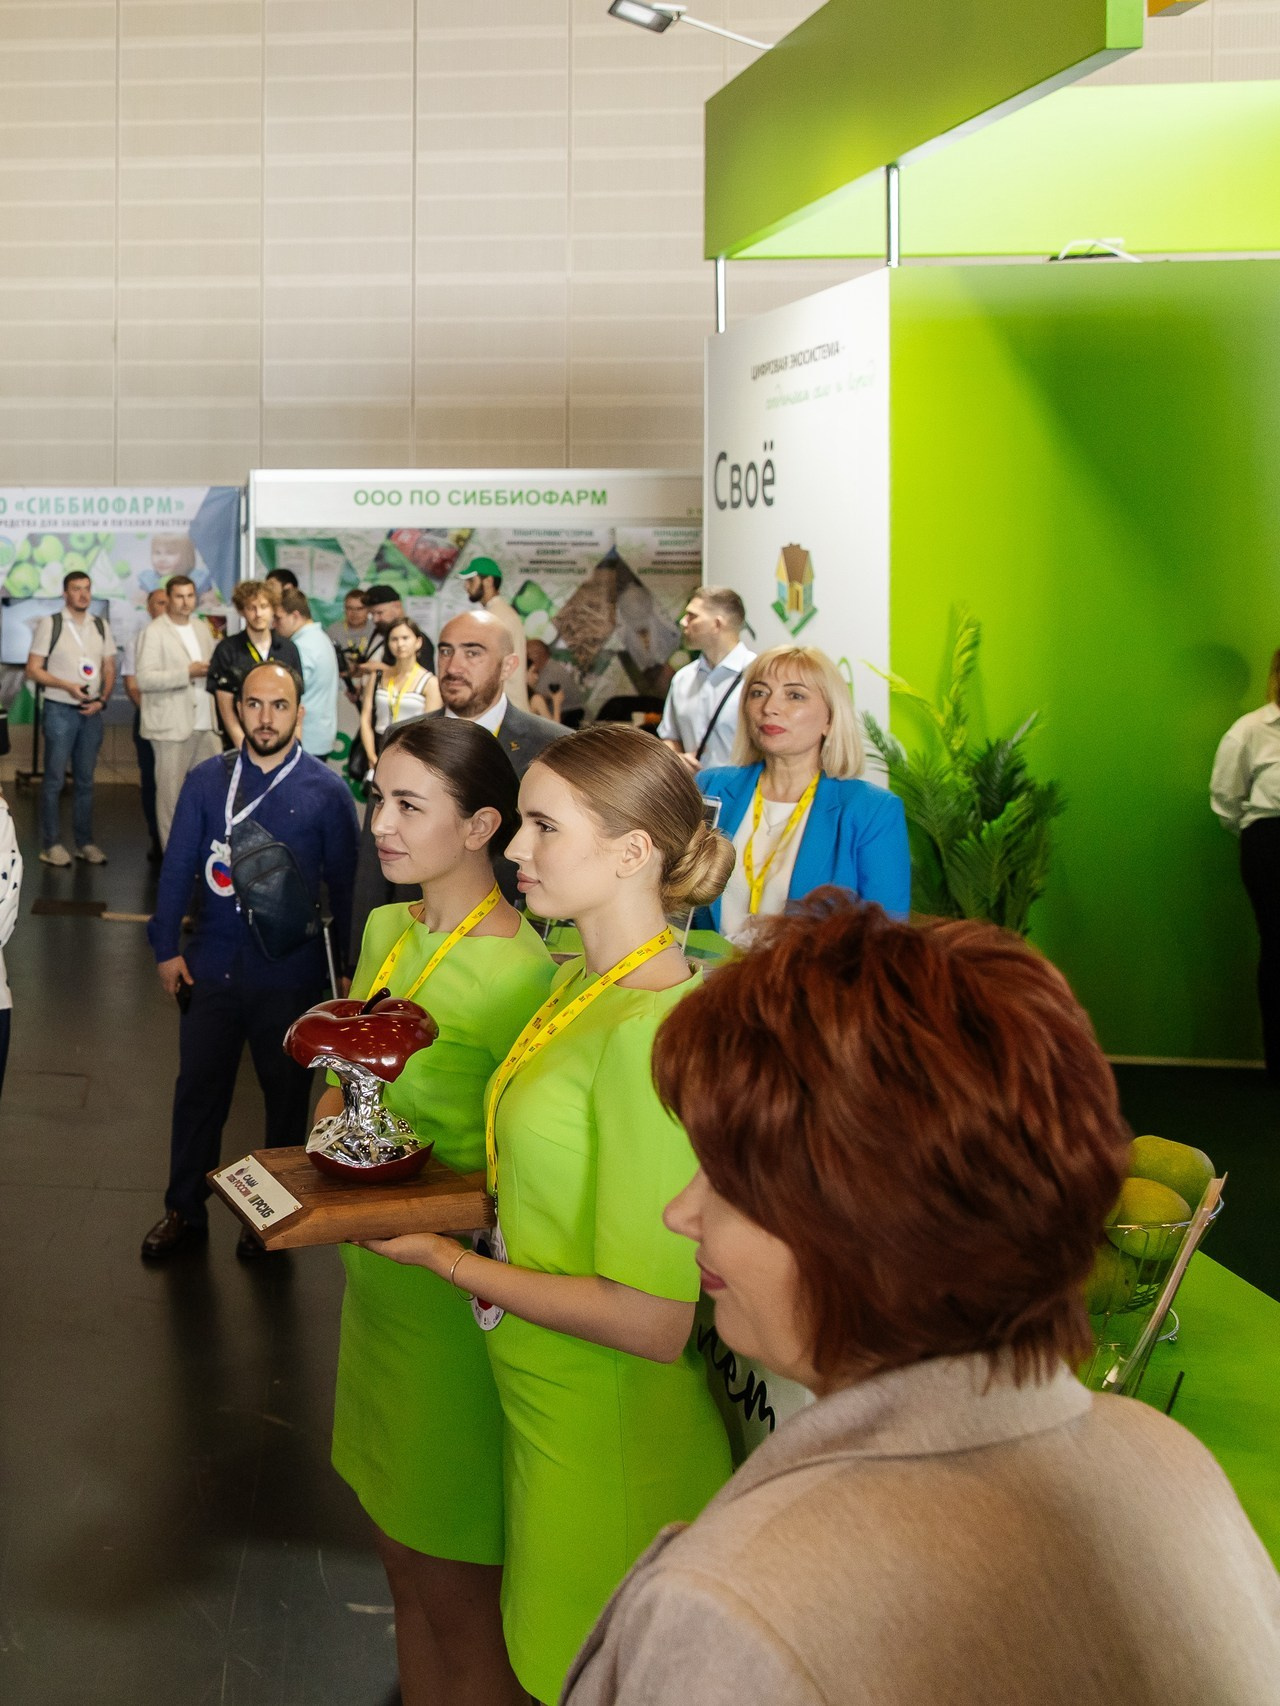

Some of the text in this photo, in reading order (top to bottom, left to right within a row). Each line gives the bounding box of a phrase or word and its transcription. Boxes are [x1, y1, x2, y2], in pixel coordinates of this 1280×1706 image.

[714, 440, 775, 511] Своё
[14, 496, 185, 515] «СИББИОФАРМ»
[354, 488, 608, 506] ООО ПО СИББИОФАРМ
[252, 1196, 275, 1218] РСХБ
